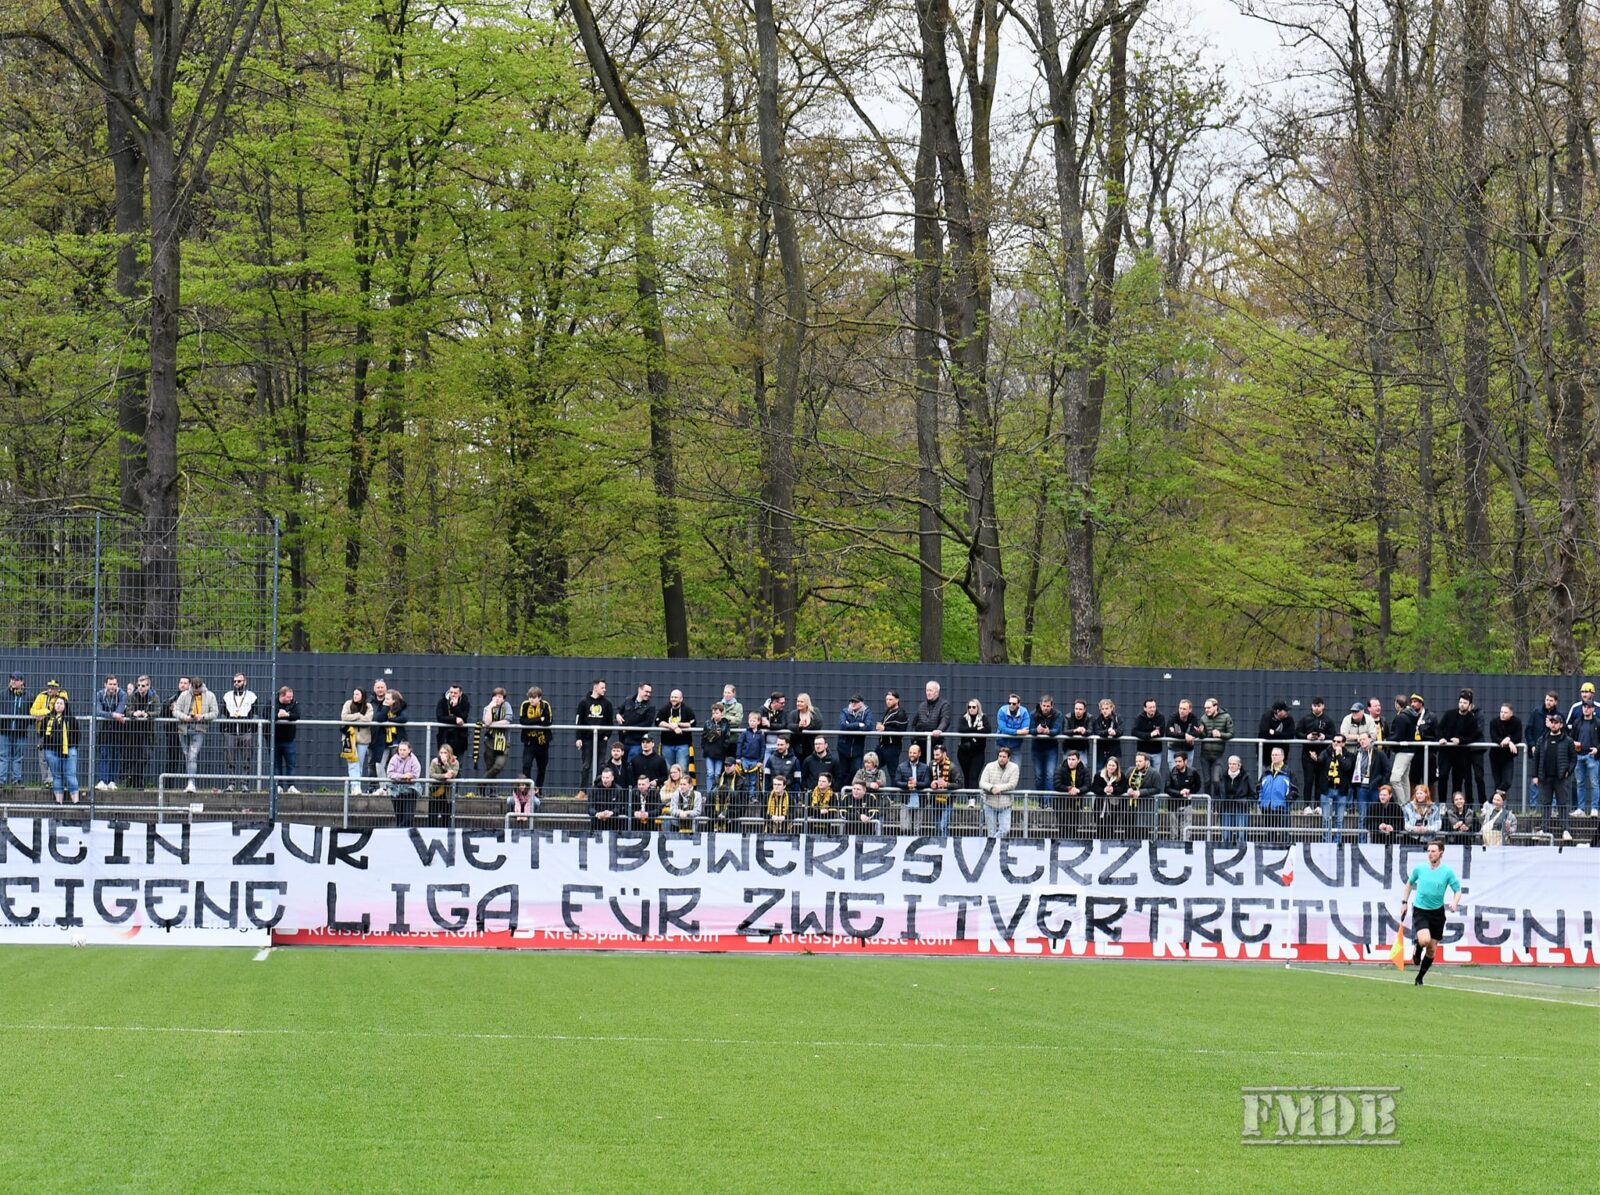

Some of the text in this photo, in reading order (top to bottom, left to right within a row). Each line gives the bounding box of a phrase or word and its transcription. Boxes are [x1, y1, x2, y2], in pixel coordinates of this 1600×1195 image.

[0, 818, 190, 865] NEIN
[232, 821, 373, 869] ZUR
[0, 876, 287, 928] EIGENE
[327, 880, 519, 931] LIGA
[562, 886, 701, 936] FÜR
